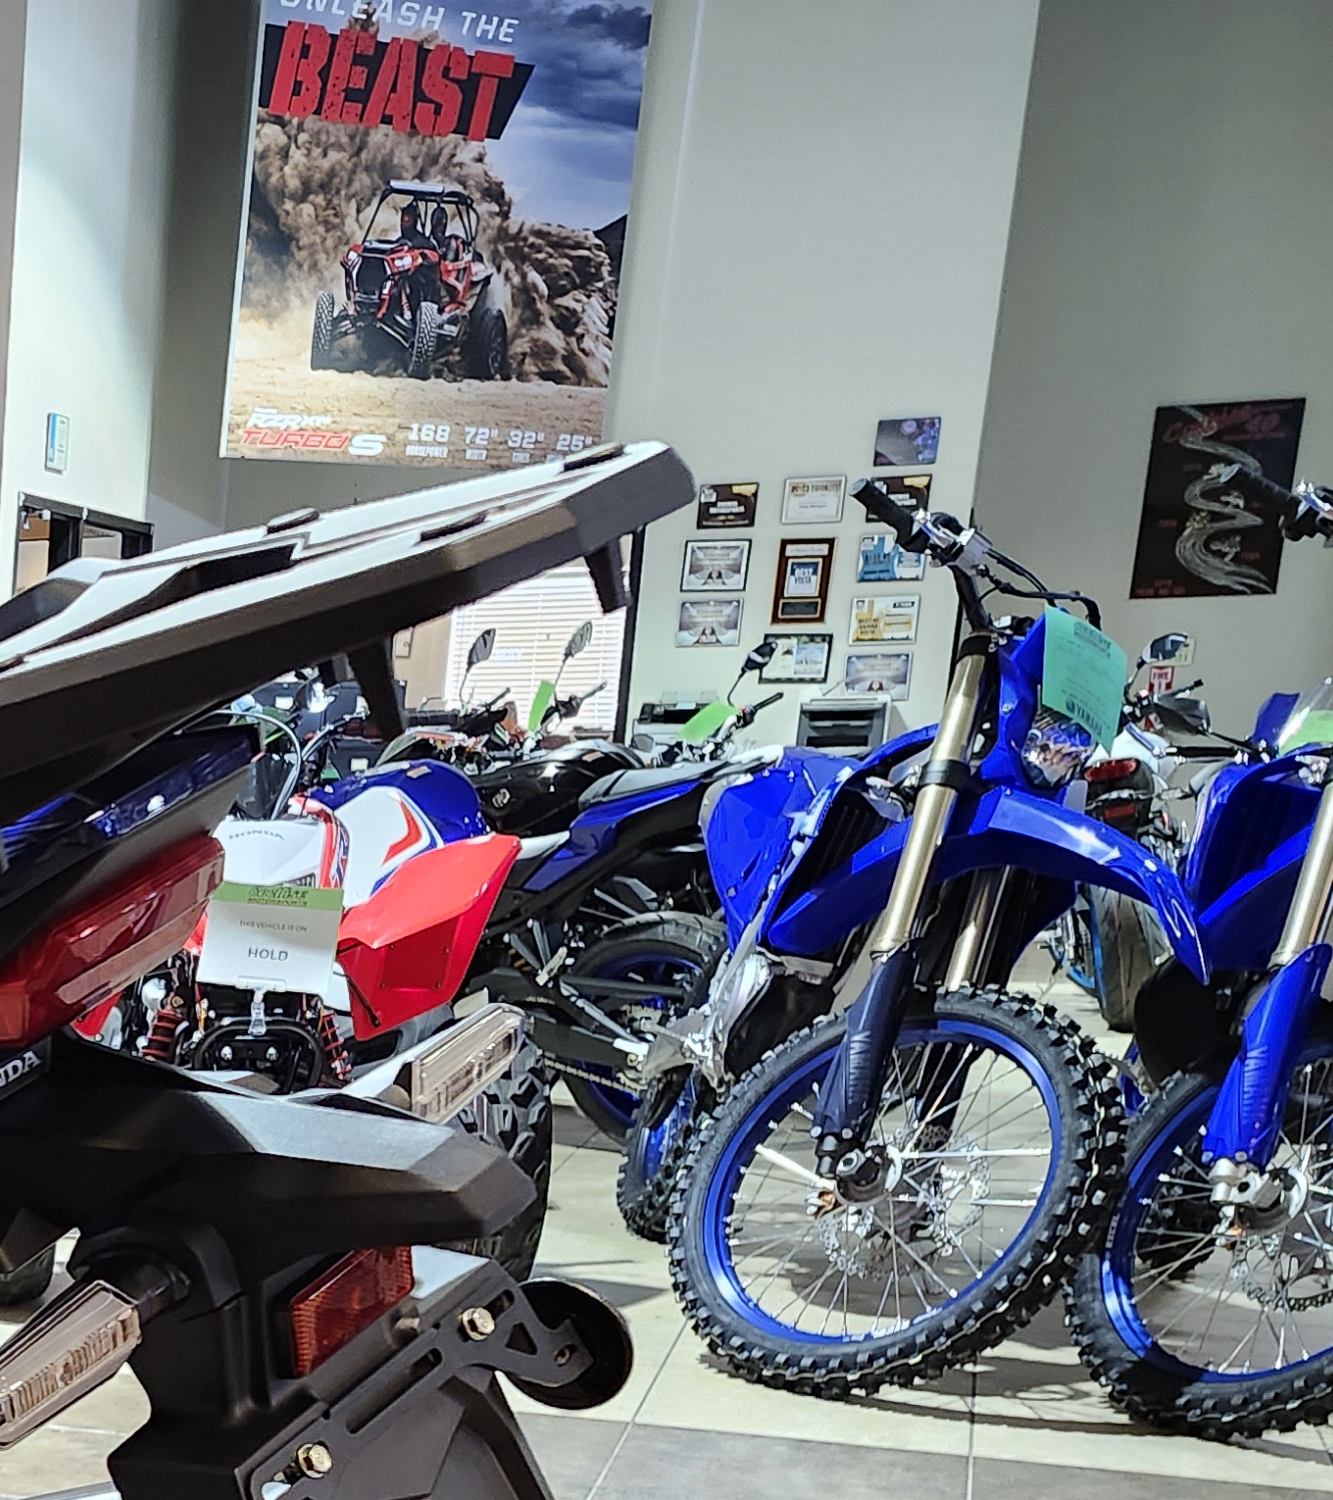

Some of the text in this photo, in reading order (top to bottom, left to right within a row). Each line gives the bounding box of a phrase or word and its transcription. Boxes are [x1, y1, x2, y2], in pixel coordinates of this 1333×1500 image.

[461, 11, 520, 43] THE
[269, 20, 515, 142] BEAST
[242, 428, 387, 456] TURBO S
[408, 422, 450, 443] 168
[239, 919, 255, 928] THIS
[256, 922, 285, 931] VEHICLE
[248, 946, 289, 961] HOLD
